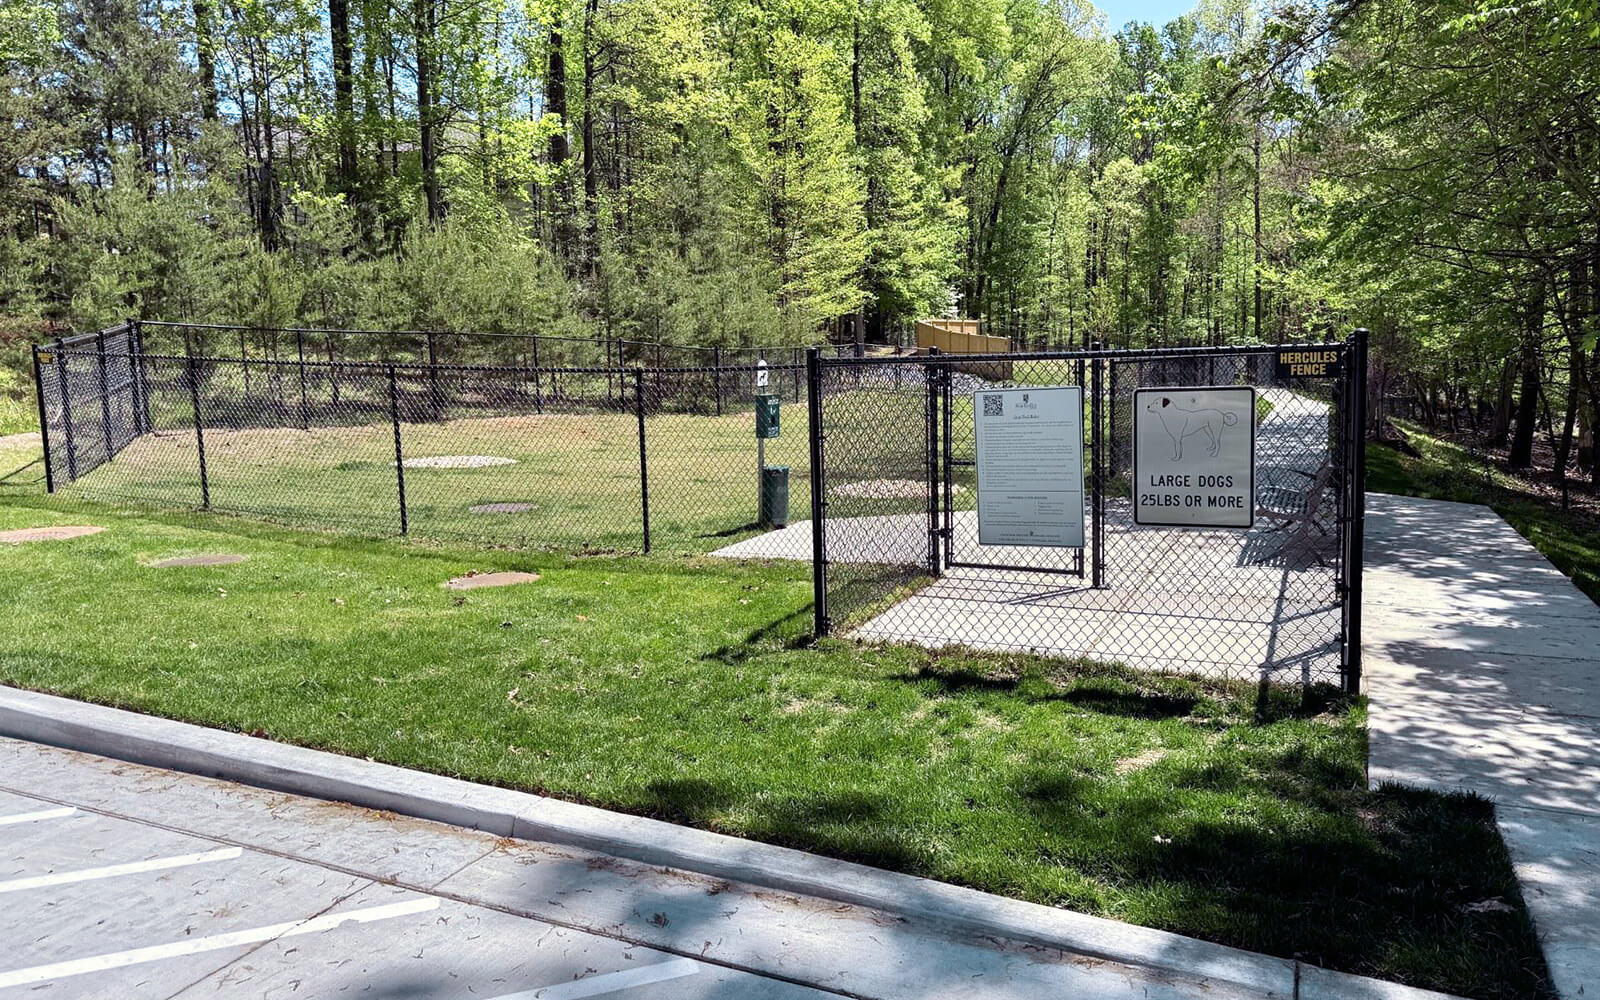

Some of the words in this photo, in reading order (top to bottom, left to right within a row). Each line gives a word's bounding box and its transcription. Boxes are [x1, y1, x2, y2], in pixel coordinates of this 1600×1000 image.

[1280, 351, 1338, 364] HERCULES
[1290, 364, 1327, 376] FENCE
[1151, 475, 1191, 487] LARGE
[1198, 475, 1233, 488] DOGS
[1141, 494, 1181, 507] 25LBS
[1185, 495, 1202, 507] OR
[1208, 495, 1244, 508] MORE
